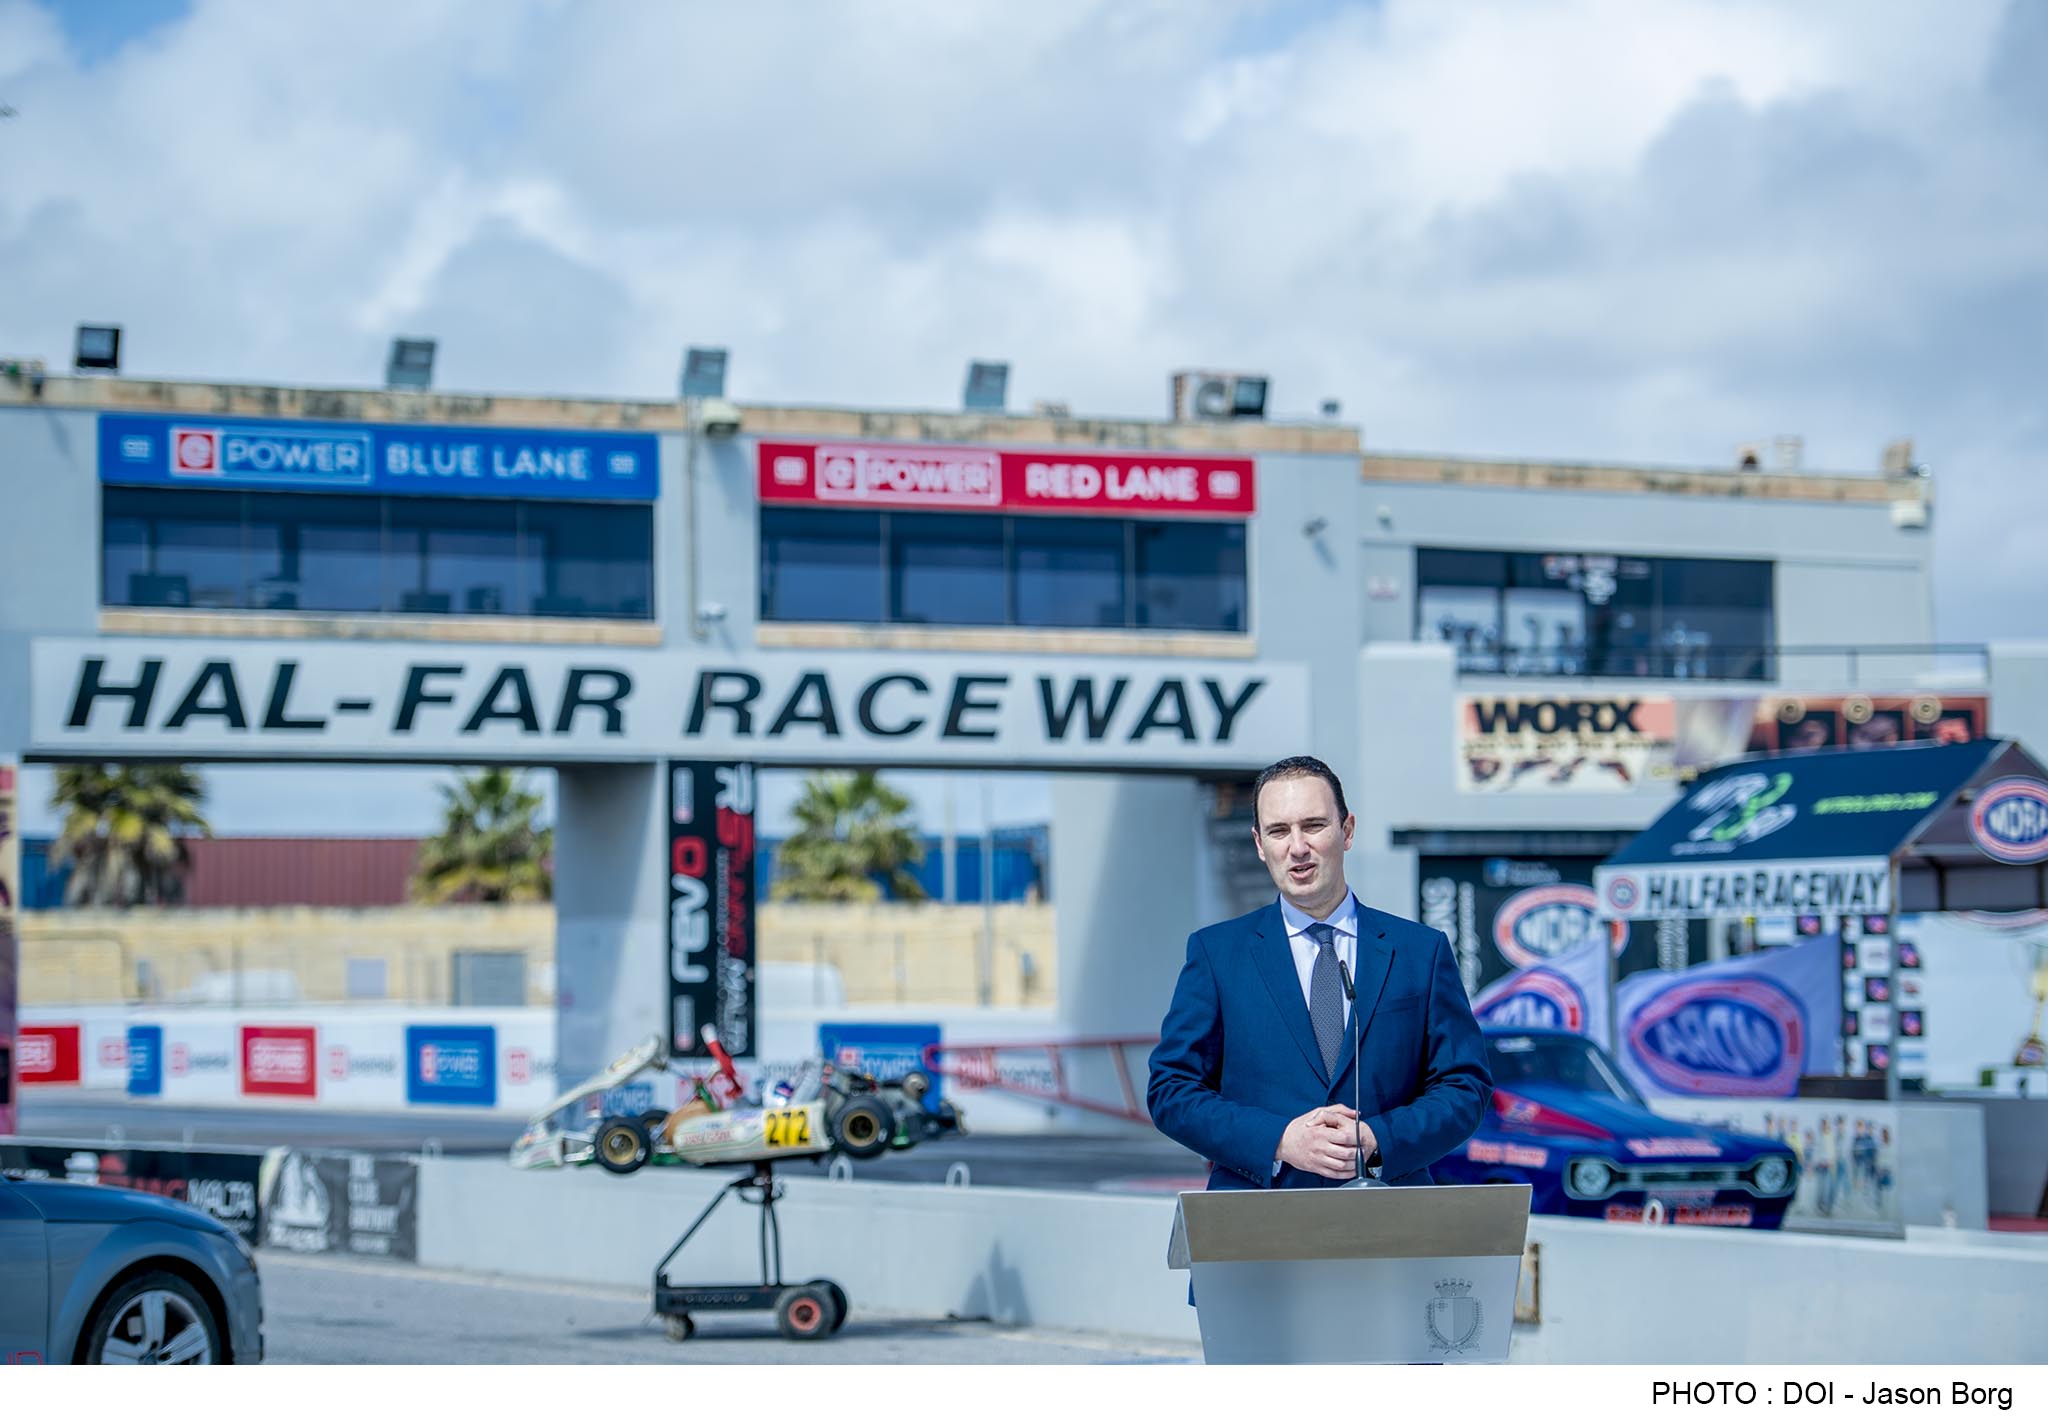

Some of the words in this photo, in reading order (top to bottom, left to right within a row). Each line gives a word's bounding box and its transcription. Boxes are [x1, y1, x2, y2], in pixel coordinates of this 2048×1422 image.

[226, 438, 359, 473] POWER
[385, 441, 479, 477] BLUE
[493, 446, 588, 480] LANE
[867, 459, 990, 492] POWER
[1025, 462, 1102, 499] RED
[1105, 465, 1199, 501] LANE
[66, 660, 633, 733] HAL-FAR
[1473, 701, 1643, 734] WORX
[768, 1110, 808, 1145] 272
